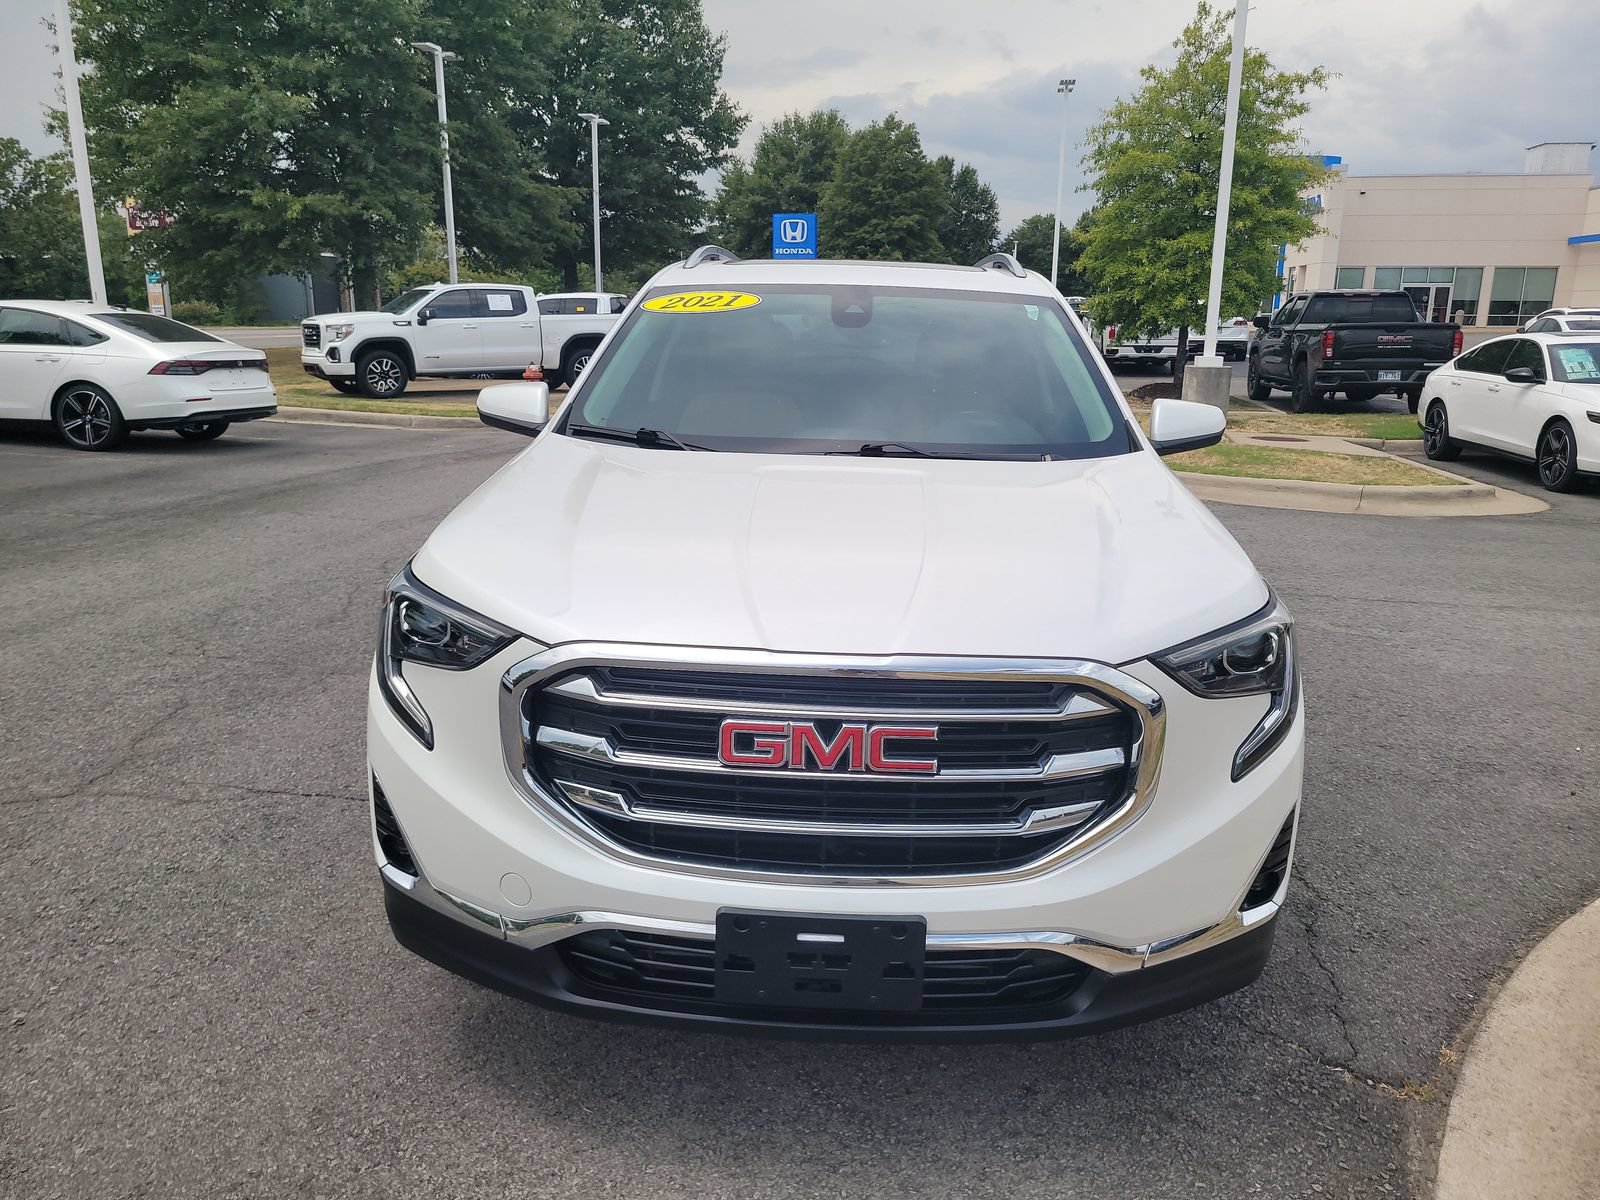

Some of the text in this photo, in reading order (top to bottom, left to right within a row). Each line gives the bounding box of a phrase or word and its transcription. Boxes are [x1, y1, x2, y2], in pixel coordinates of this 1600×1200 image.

[659, 295, 743, 310] 2021
[1377, 335, 1413, 343] GMC
[718, 718, 939, 774] GMC
